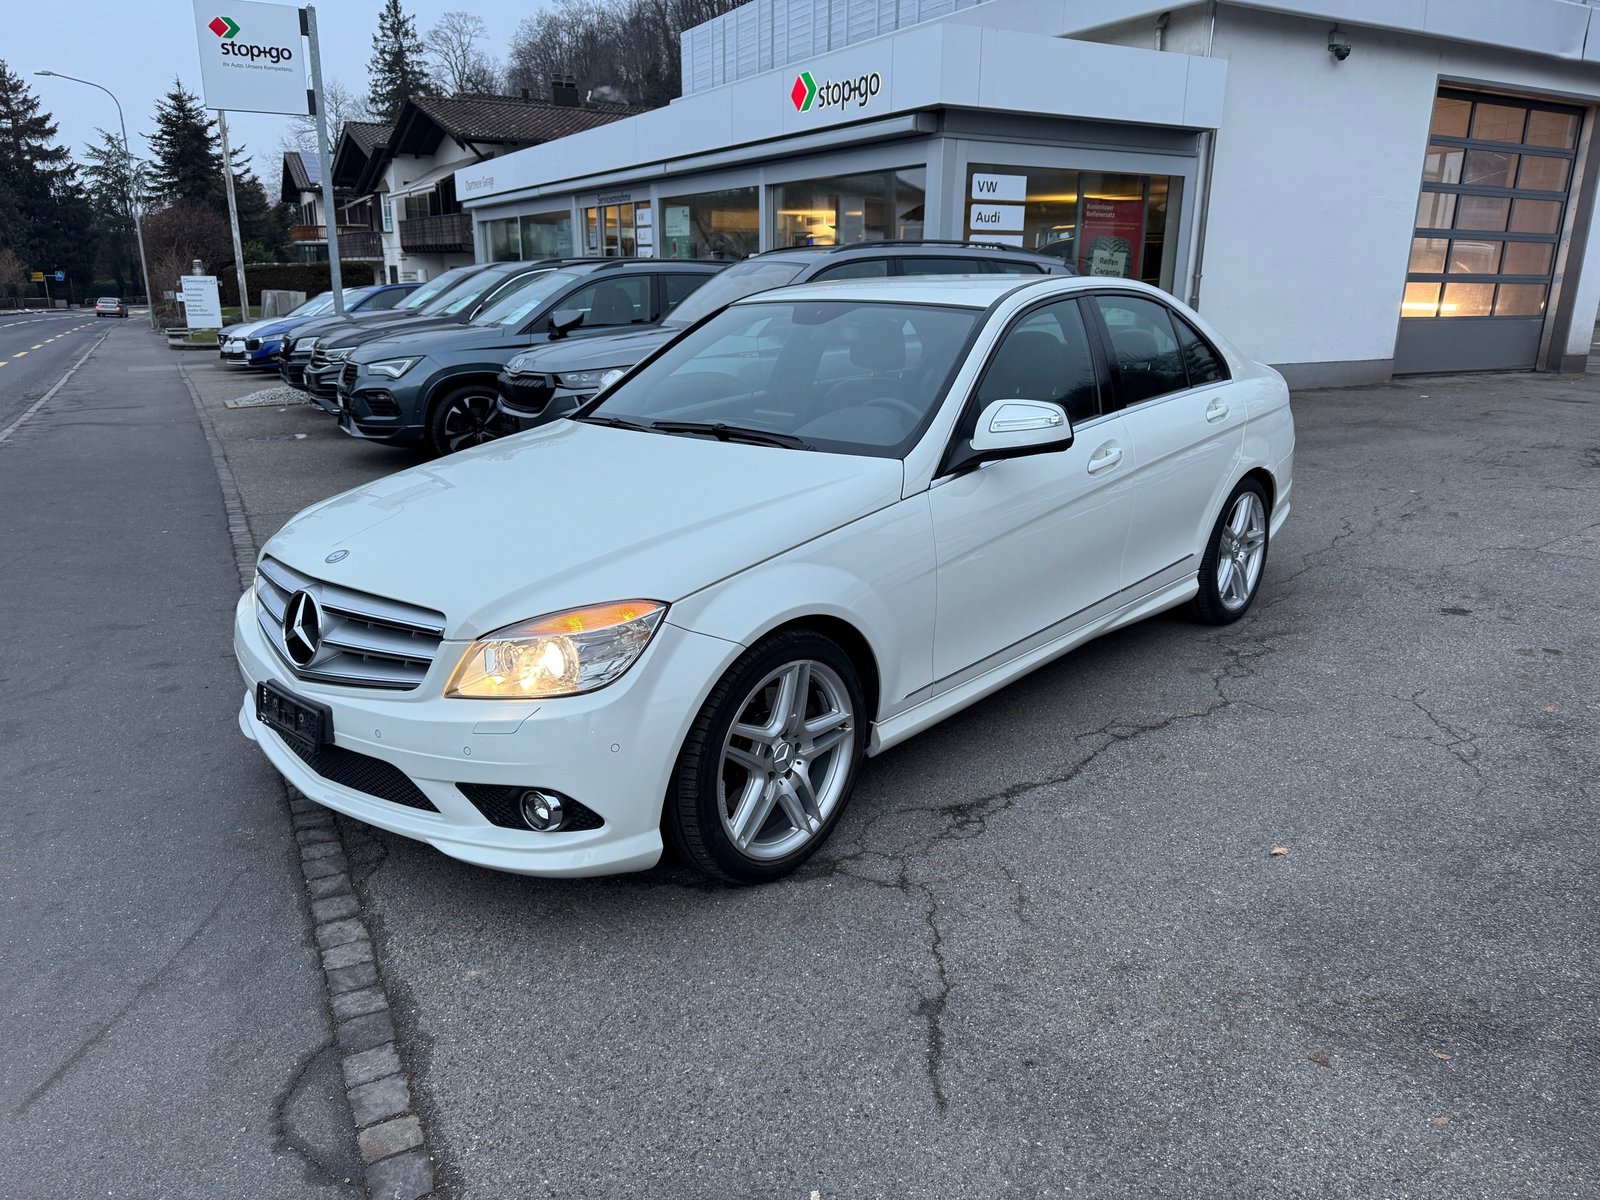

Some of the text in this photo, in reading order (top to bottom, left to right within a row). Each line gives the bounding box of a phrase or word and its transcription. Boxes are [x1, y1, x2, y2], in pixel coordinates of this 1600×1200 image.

[221, 41, 292, 63] stop+go
[818, 72, 880, 110] stop+go
[977, 180, 998, 193] VW
[975, 211, 1001, 223] Audi
[1099, 257, 1119, 266] Reifen
[1094, 267, 1121, 276] Garantie
